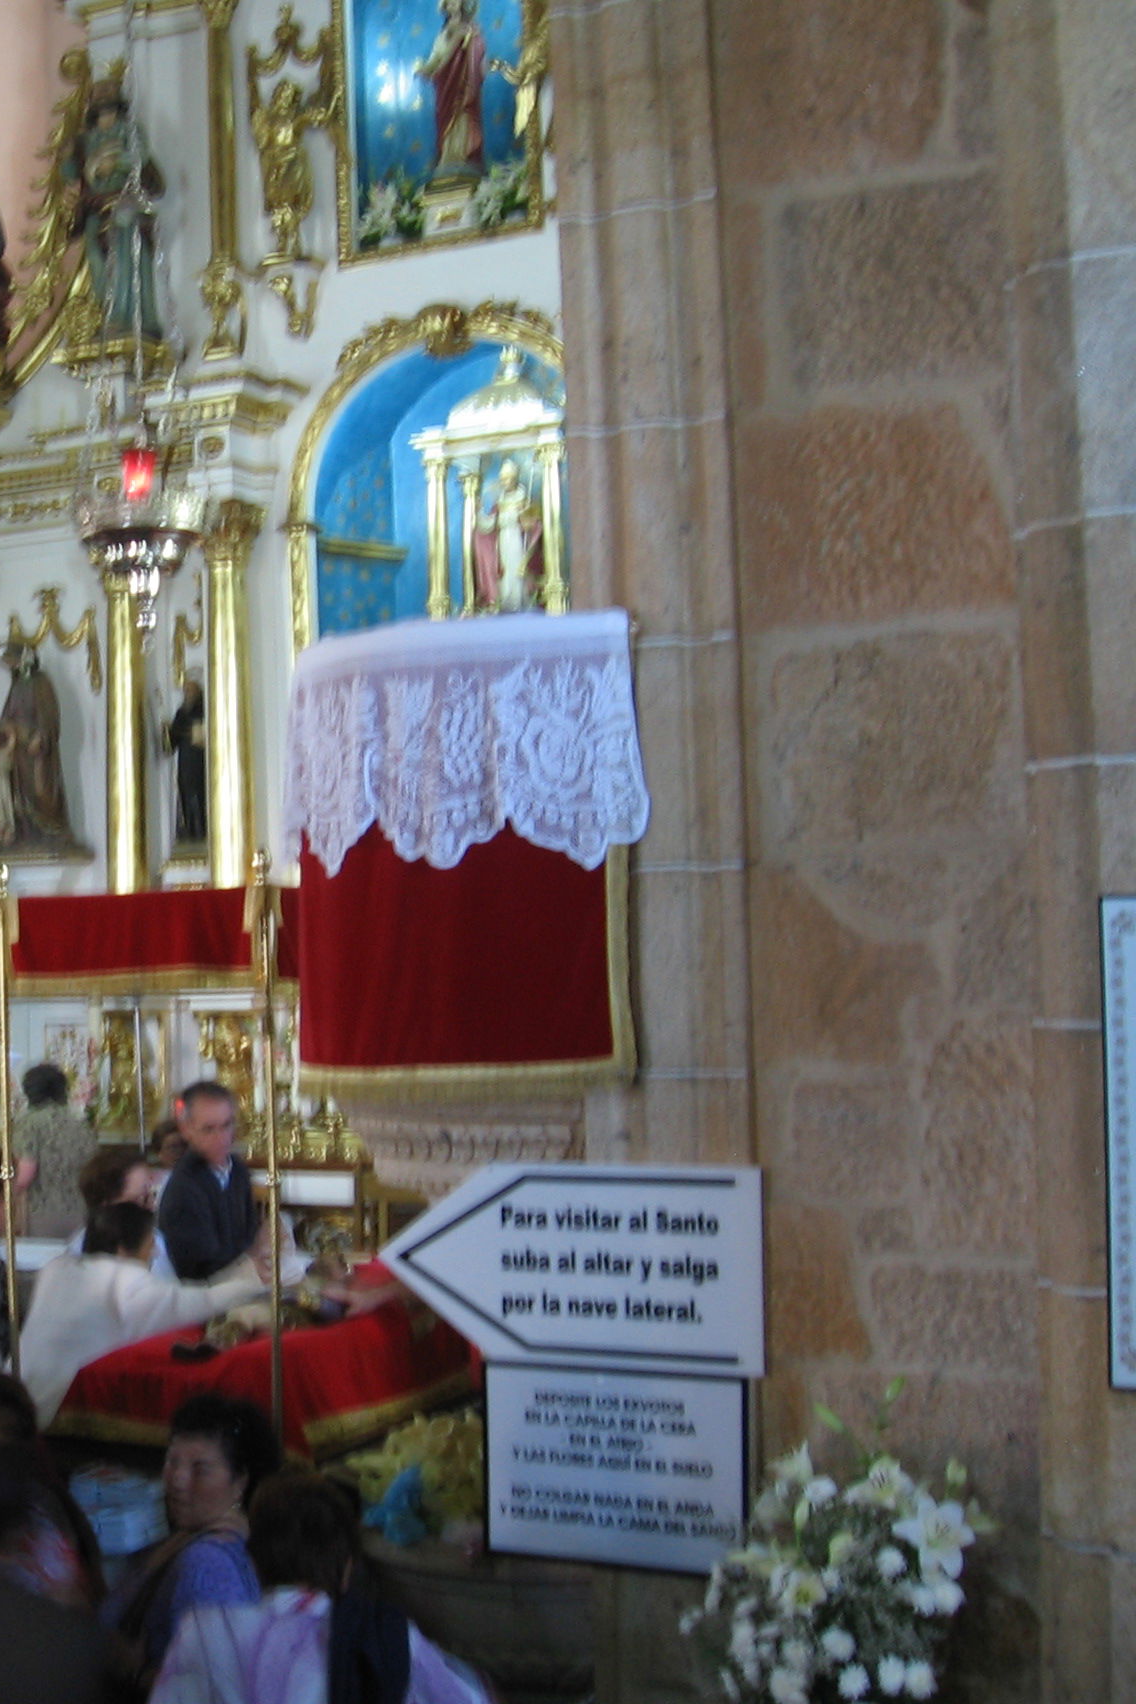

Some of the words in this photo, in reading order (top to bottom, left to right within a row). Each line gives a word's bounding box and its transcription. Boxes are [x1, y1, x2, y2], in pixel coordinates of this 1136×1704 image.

[500, 1205, 548, 1229] Para
[556, 1204, 621, 1231] visitar
[629, 1208, 648, 1231] al
[656, 1207, 719, 1234] Santo
[501, 1246, 550, 1270] suba
[558, 1248, 575, 1272] al
[583, 1250, 634, 1275] altar
[640, 1257, 651, 1283] y
[661, 1254, 719, 1285] salga
[501, 1293, 535, 1317] por
[542, 1291, 561, 1314] la
[568, 1298, 617, 1317] nave
[625, 1295, 702, 1323] lateral.
[596, 1394, 620, 1410] LOS
[524, 1448, 546, 1463] LAS
